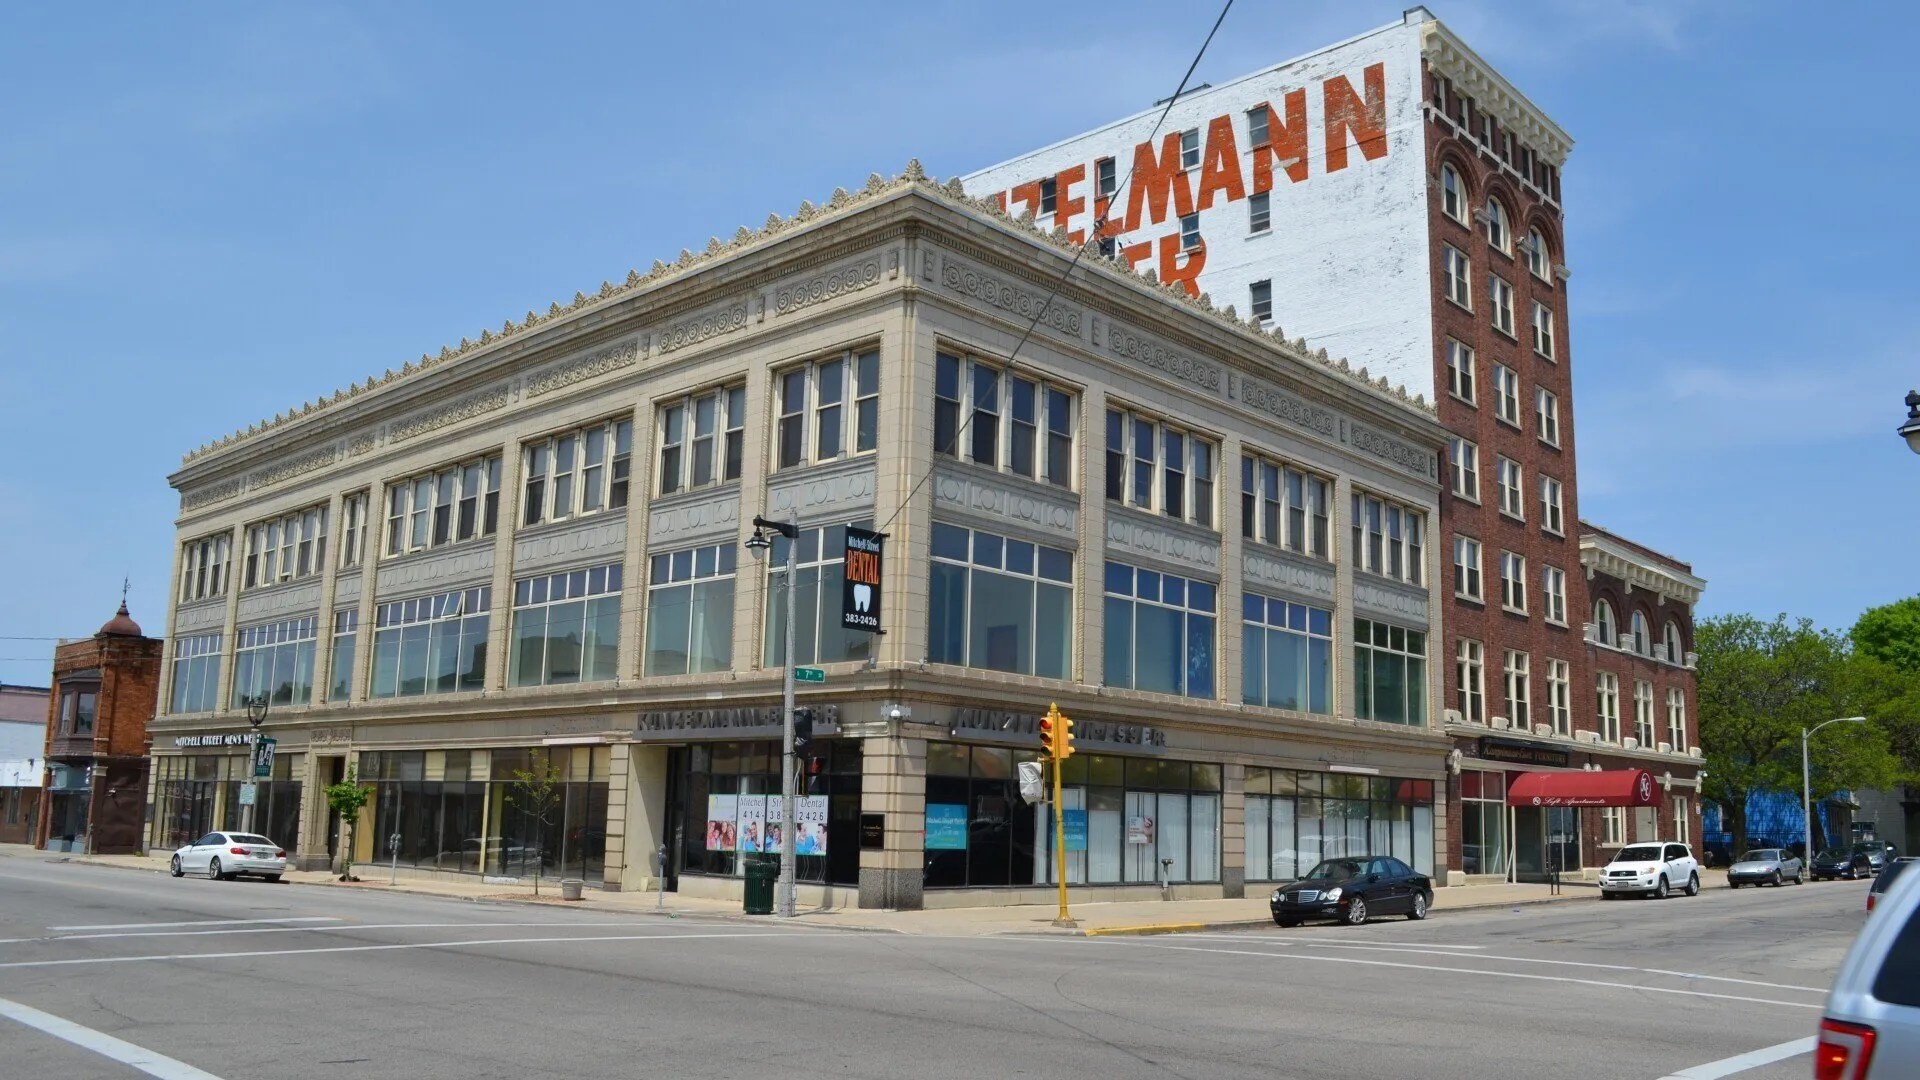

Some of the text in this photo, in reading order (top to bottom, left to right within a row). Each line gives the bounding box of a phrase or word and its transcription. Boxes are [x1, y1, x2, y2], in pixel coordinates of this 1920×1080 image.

[996, 62, 1387, 246] ZELMANN
[848, 535, 866, 549] Mitchell
[847, 549, 879, 585] DENTAL
[845, 613, 877, 626] 383-2426
[175, 736, 201, 747] MITCHELL
[202, 735, 223, 746] STREET
[243, 733, 262, 745] WER
[740, 797, 765, 808] Mitchell
[801, 798, 825, 808] Dental
[1543, 796, 1561, 806] Loft
[1562, 796, 1606, 806] Apartments
